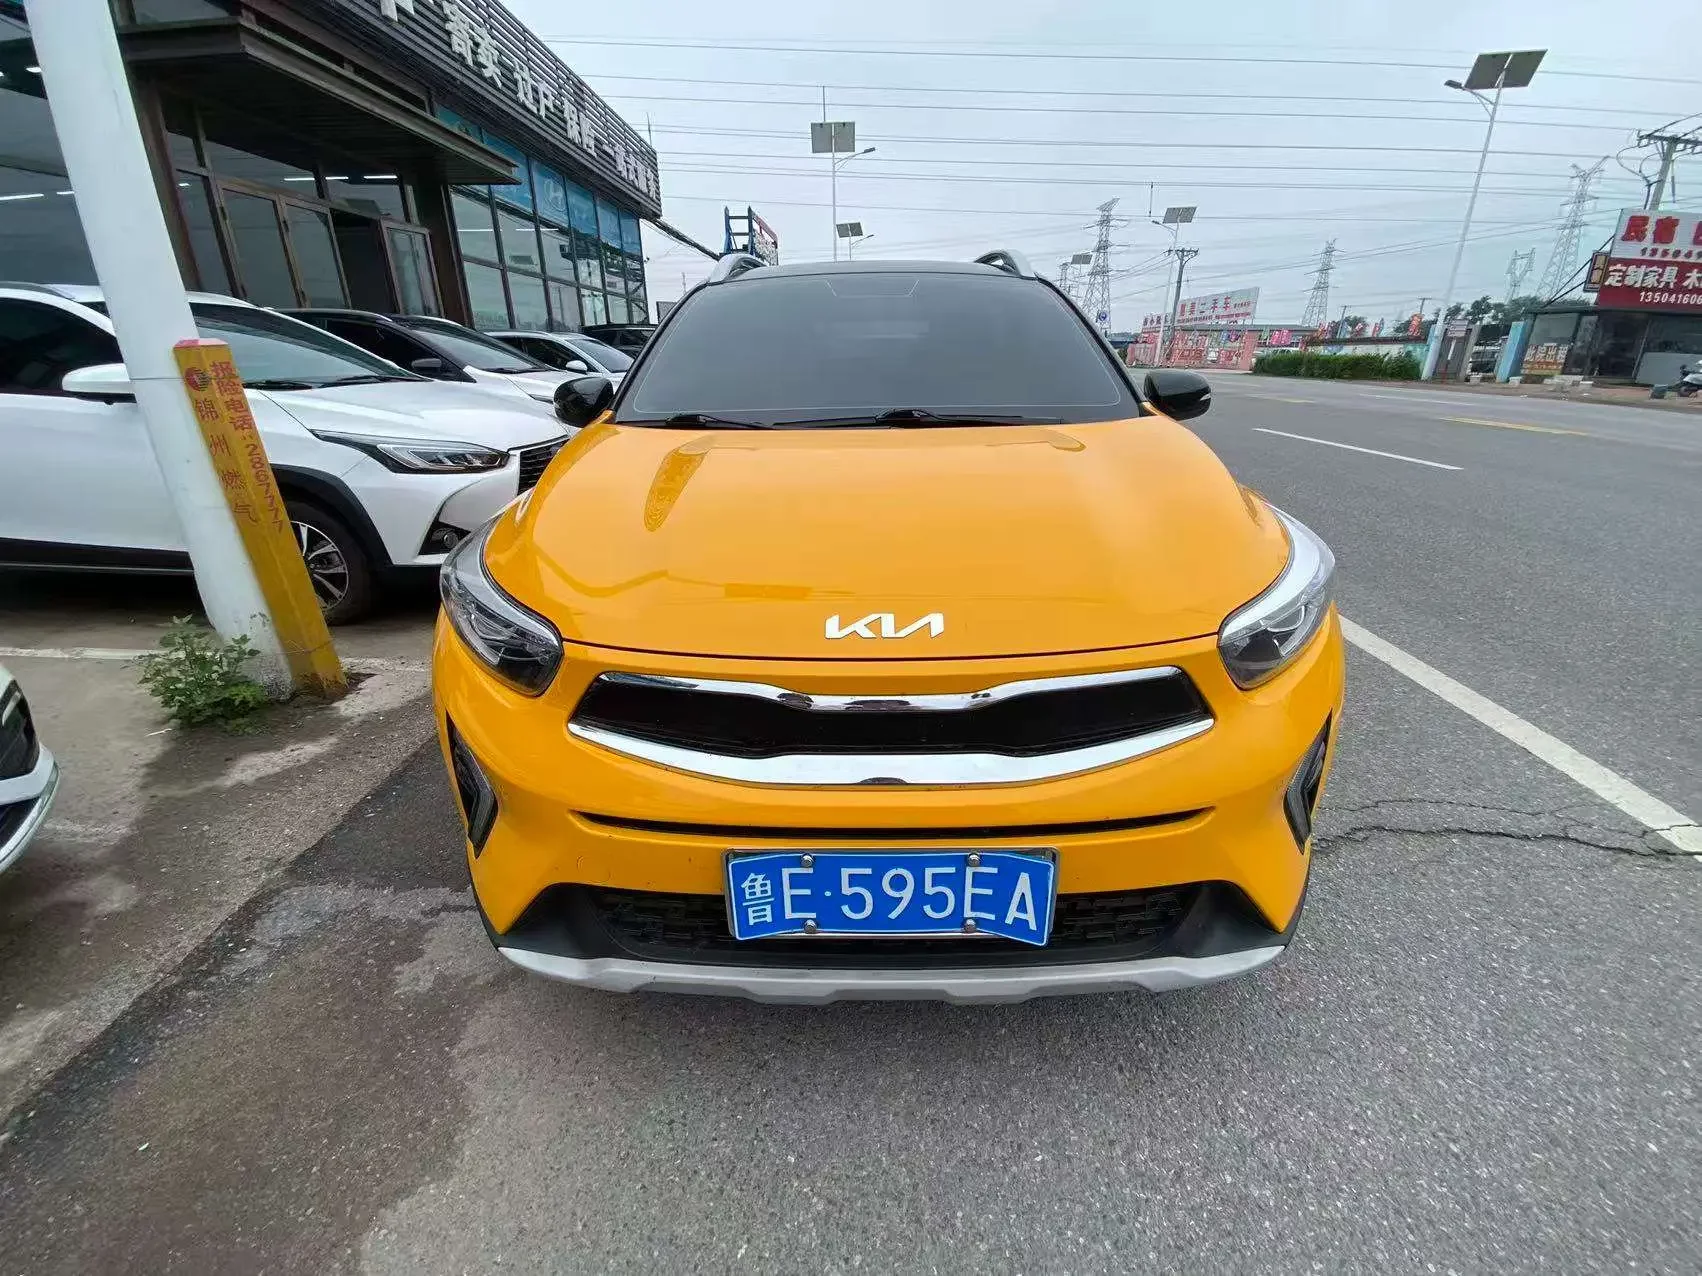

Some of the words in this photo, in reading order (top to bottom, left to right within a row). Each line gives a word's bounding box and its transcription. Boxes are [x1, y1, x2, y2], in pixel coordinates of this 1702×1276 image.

[1604, 264, 1679, 289] 定制家具
[194, 397, 259, 524] 锦州燃气
[825, 612, 945, 640] KIA
